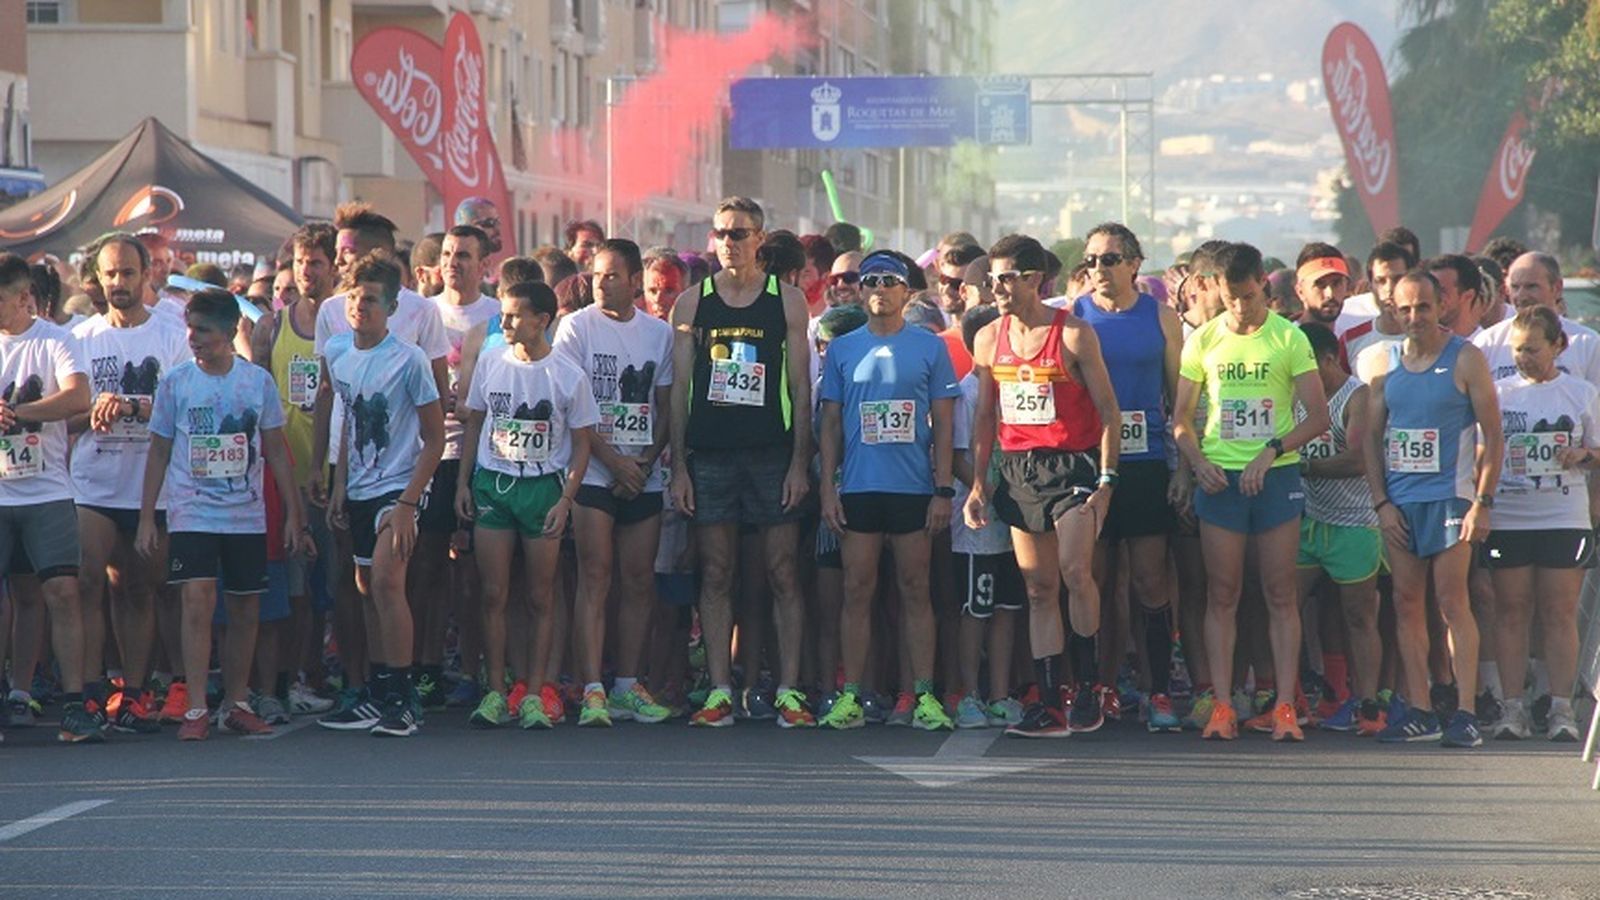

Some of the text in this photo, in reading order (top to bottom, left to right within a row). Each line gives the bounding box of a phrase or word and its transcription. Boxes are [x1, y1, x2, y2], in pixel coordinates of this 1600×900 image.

[592, 353, 617, 377] CROSS
[727, 372, 761, 392] 432
[1016, 394, 1048, 411] 257
[614, 415, 648, 431] 428
[878, 412, 911, 428] 137
[1235, 408, 1270, 426] 511
[508, 431, 543, 448] 270
[6, 446, 32, 465] 14
[208, 447, 245, 462] 2183
[1400, 441, 1434, 458] 158
[976, 573, 994, 606] 9
